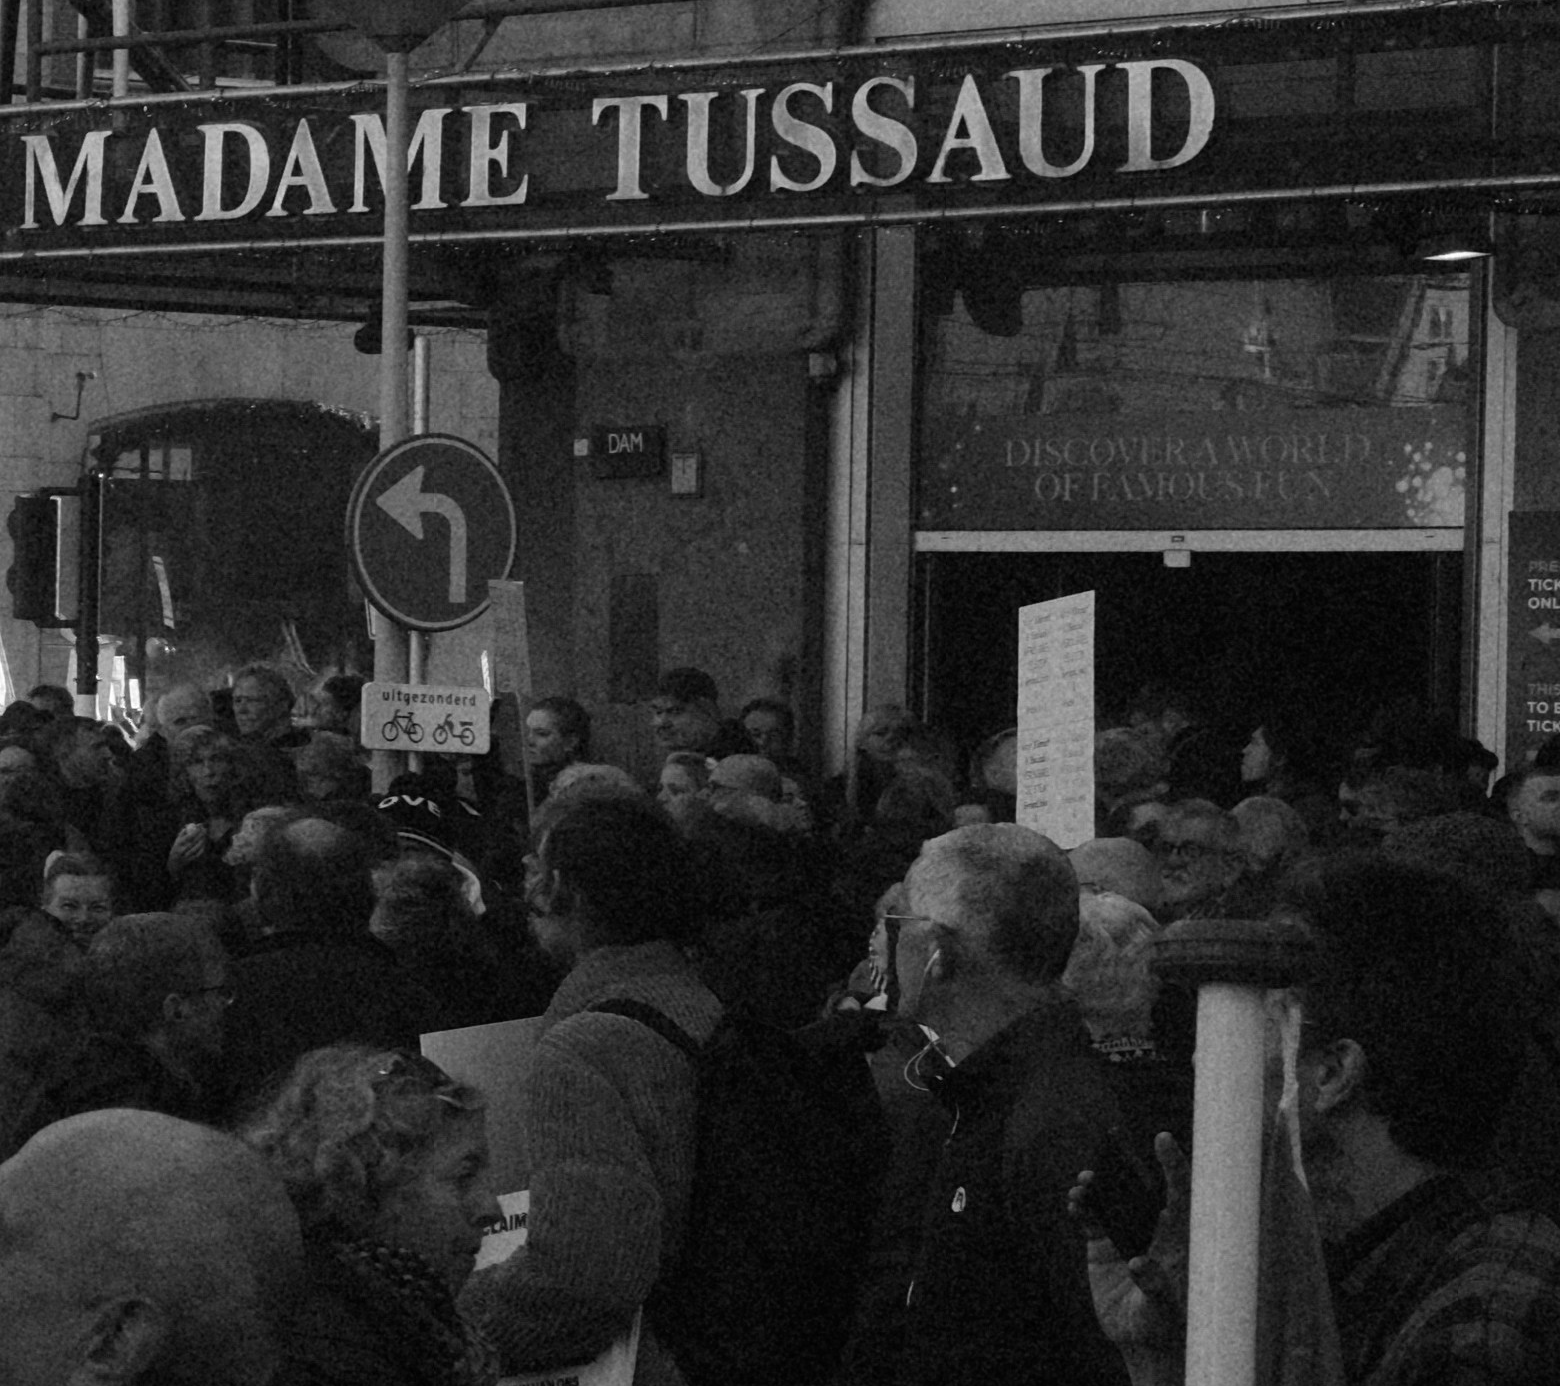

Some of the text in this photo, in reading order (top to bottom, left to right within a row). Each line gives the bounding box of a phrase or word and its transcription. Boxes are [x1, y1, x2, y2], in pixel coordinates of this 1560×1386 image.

[20, 58, 1218, 231] MADAME TUSSAUD
[608, 432, 643, 454] DAM
[1005, 435, 1186, 468] DISCOVER
[1225, 433, 1372, 466] WORLD
[1033, 471, 1082, 503] OF
[1091, 470, 1244, 502] FAMOUS
[382, 690, 477, 707] uitgezonderd
[1527, 701, 1549, 713] TO
